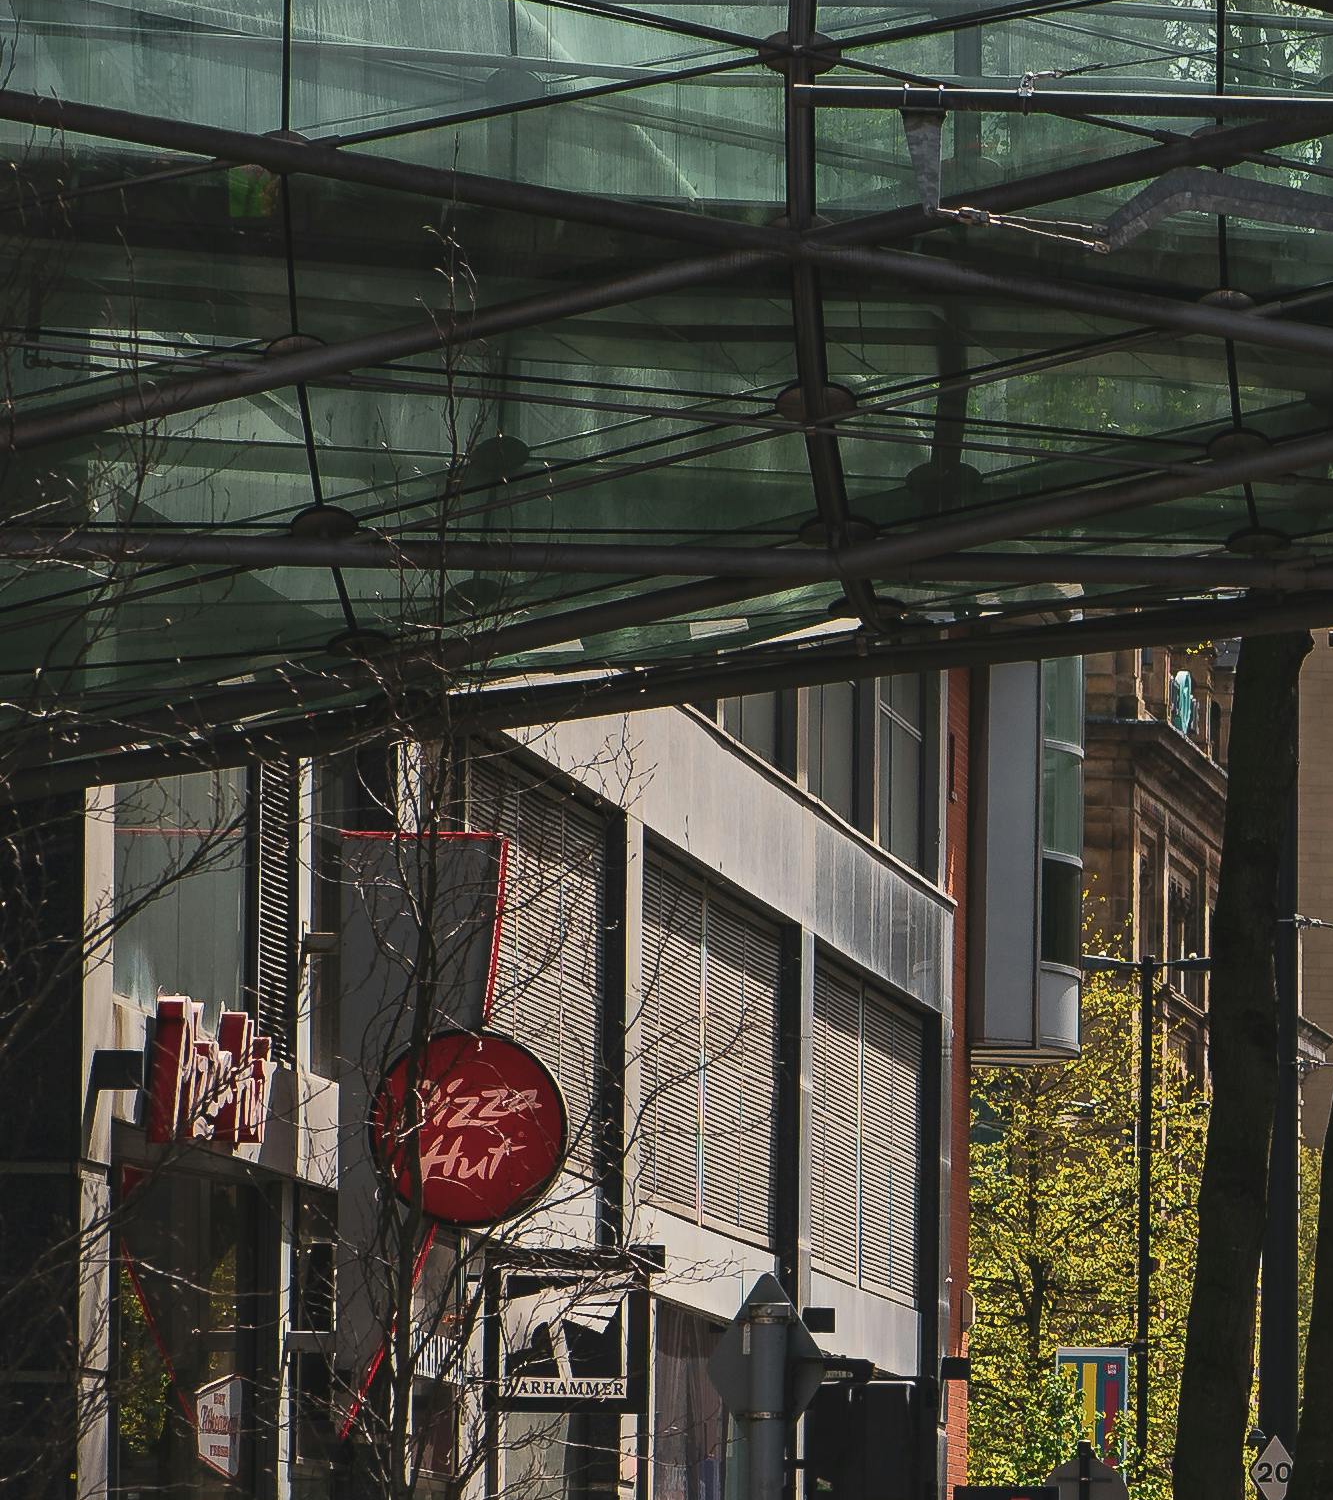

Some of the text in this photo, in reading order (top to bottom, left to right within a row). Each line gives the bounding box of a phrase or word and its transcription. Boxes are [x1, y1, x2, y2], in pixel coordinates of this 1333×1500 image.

[420, 1134, 527, 1180] Hut
[503, 1379, 625, 1396] WARHAMMER
[1257, 1462, 1292, 1484] 20
